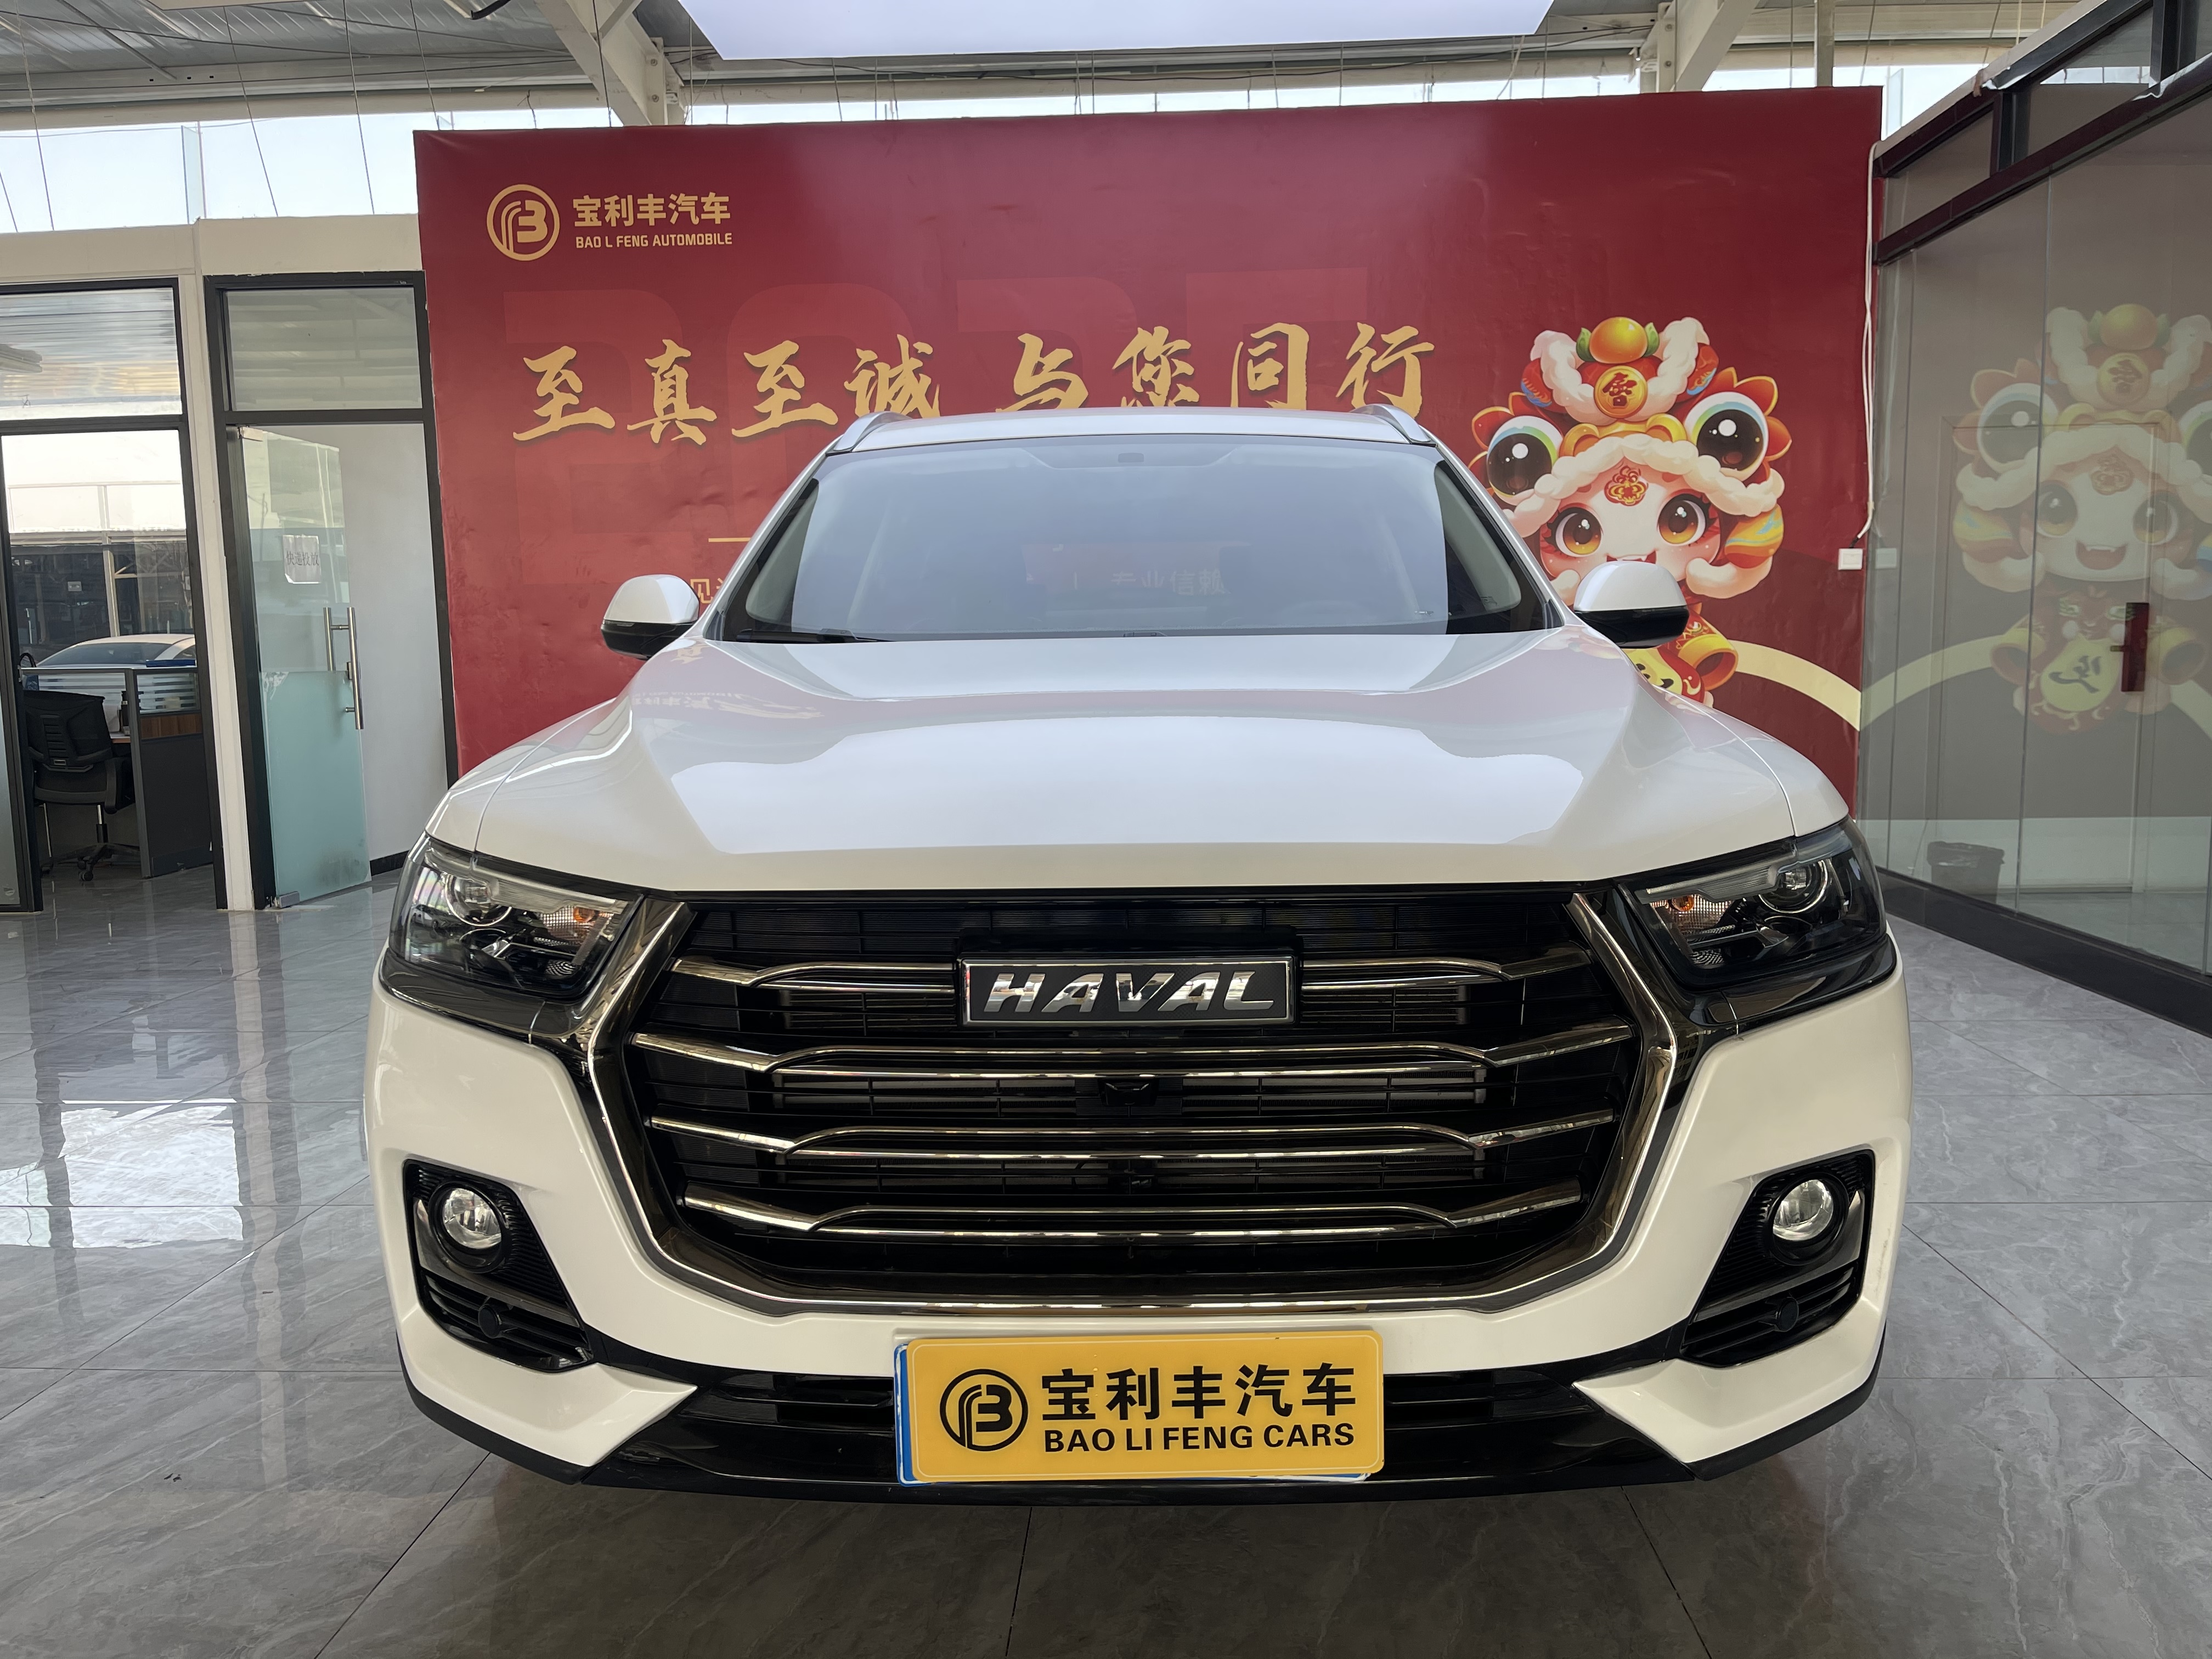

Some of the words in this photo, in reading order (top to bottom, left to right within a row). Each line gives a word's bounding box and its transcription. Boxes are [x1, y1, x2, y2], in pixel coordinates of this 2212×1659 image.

[573, 191, 731, 227] 宝利丰汽车
[575, 236, 602, 249] BAO
[616, 235, 649, 247] FENG
[652, 233, 733, 247] AUTOMOBILE
[513, 334, 940, 445] 至真至诚
[286, 550, 319, 566] 快递投放
[984, 970, 1274, 1013] HAVAL
[1041, 1362, 1356, 1421] 宝利丰汽车
[1045, 1427, 1116, 1453] BAO
[1126, 1427, 1152, 1451] LI
[1163, 1424, 1253, 1451] FENG
[1263, 1423, 1356, 1448] CARS
